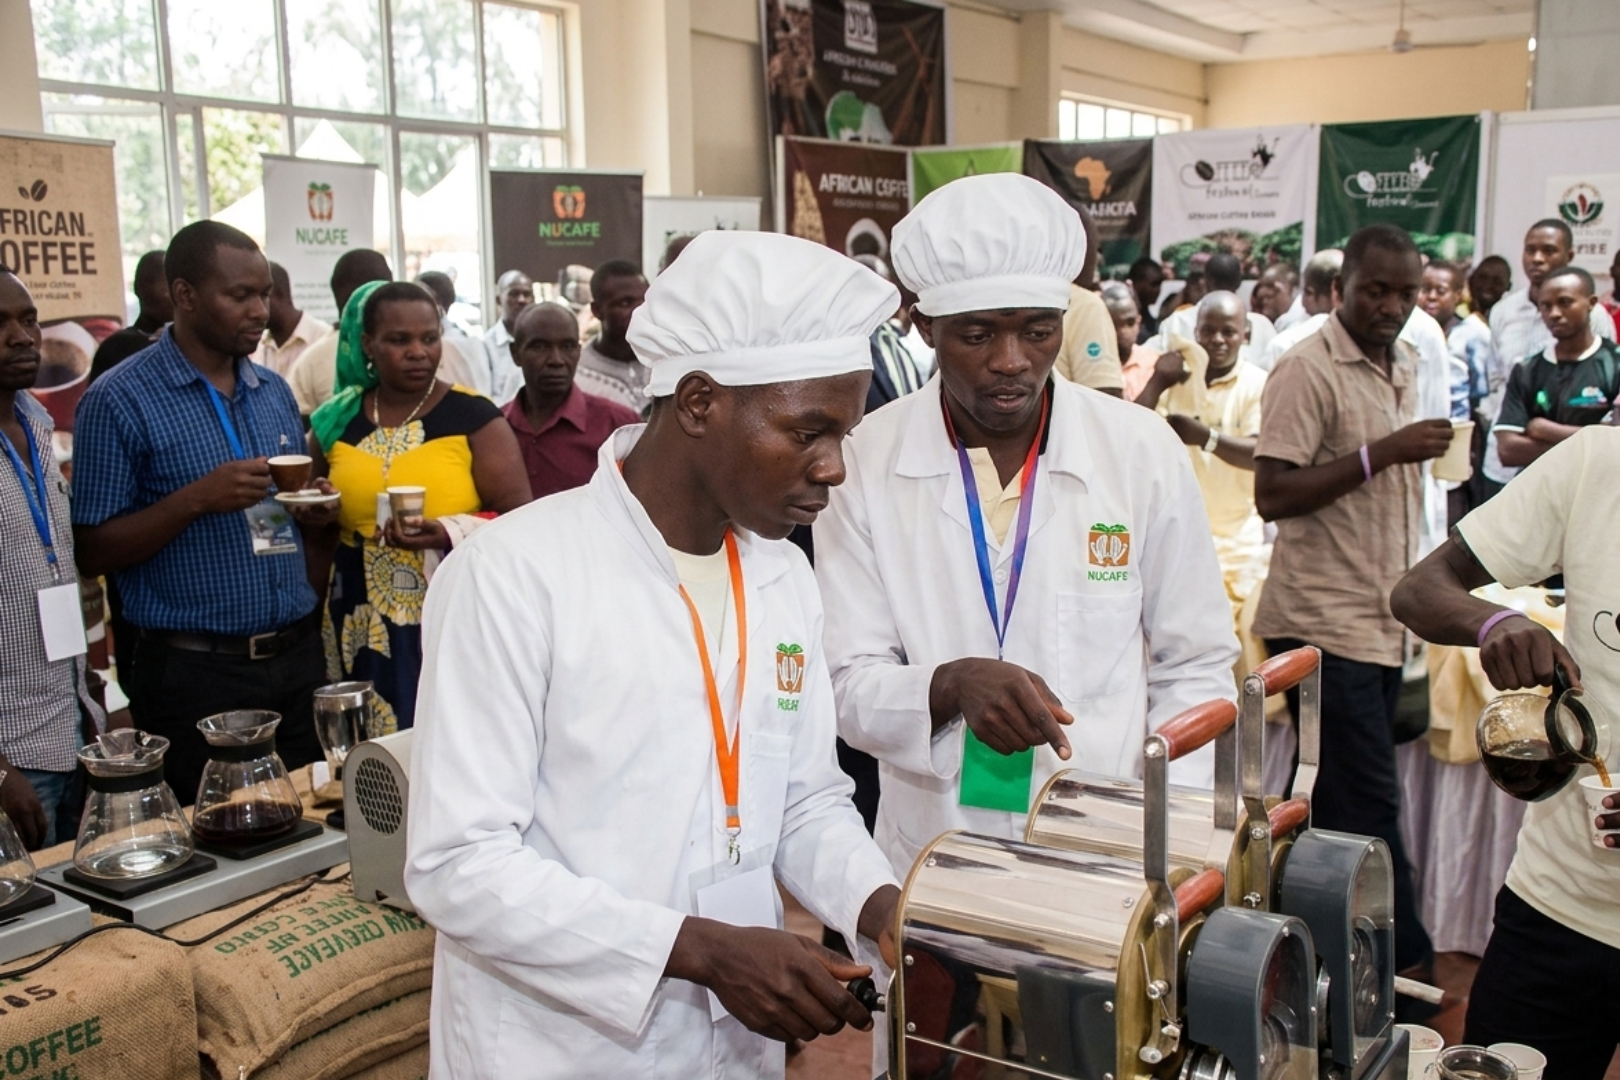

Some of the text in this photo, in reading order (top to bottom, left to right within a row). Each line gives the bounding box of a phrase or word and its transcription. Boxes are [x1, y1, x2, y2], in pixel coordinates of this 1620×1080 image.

[818, 172, 874, 195] AFRICAN
[0, 208, 86, 237] FRICAN
[539, 222, 601, 238] NUCAFE
[296, 226, 348, 246] NUCAFE
[0, 239, 98, 275] OFFEE
[1087, 571, 1129, 581] NUCAFE
[0, 1015, 103, 1078] OFFEE
